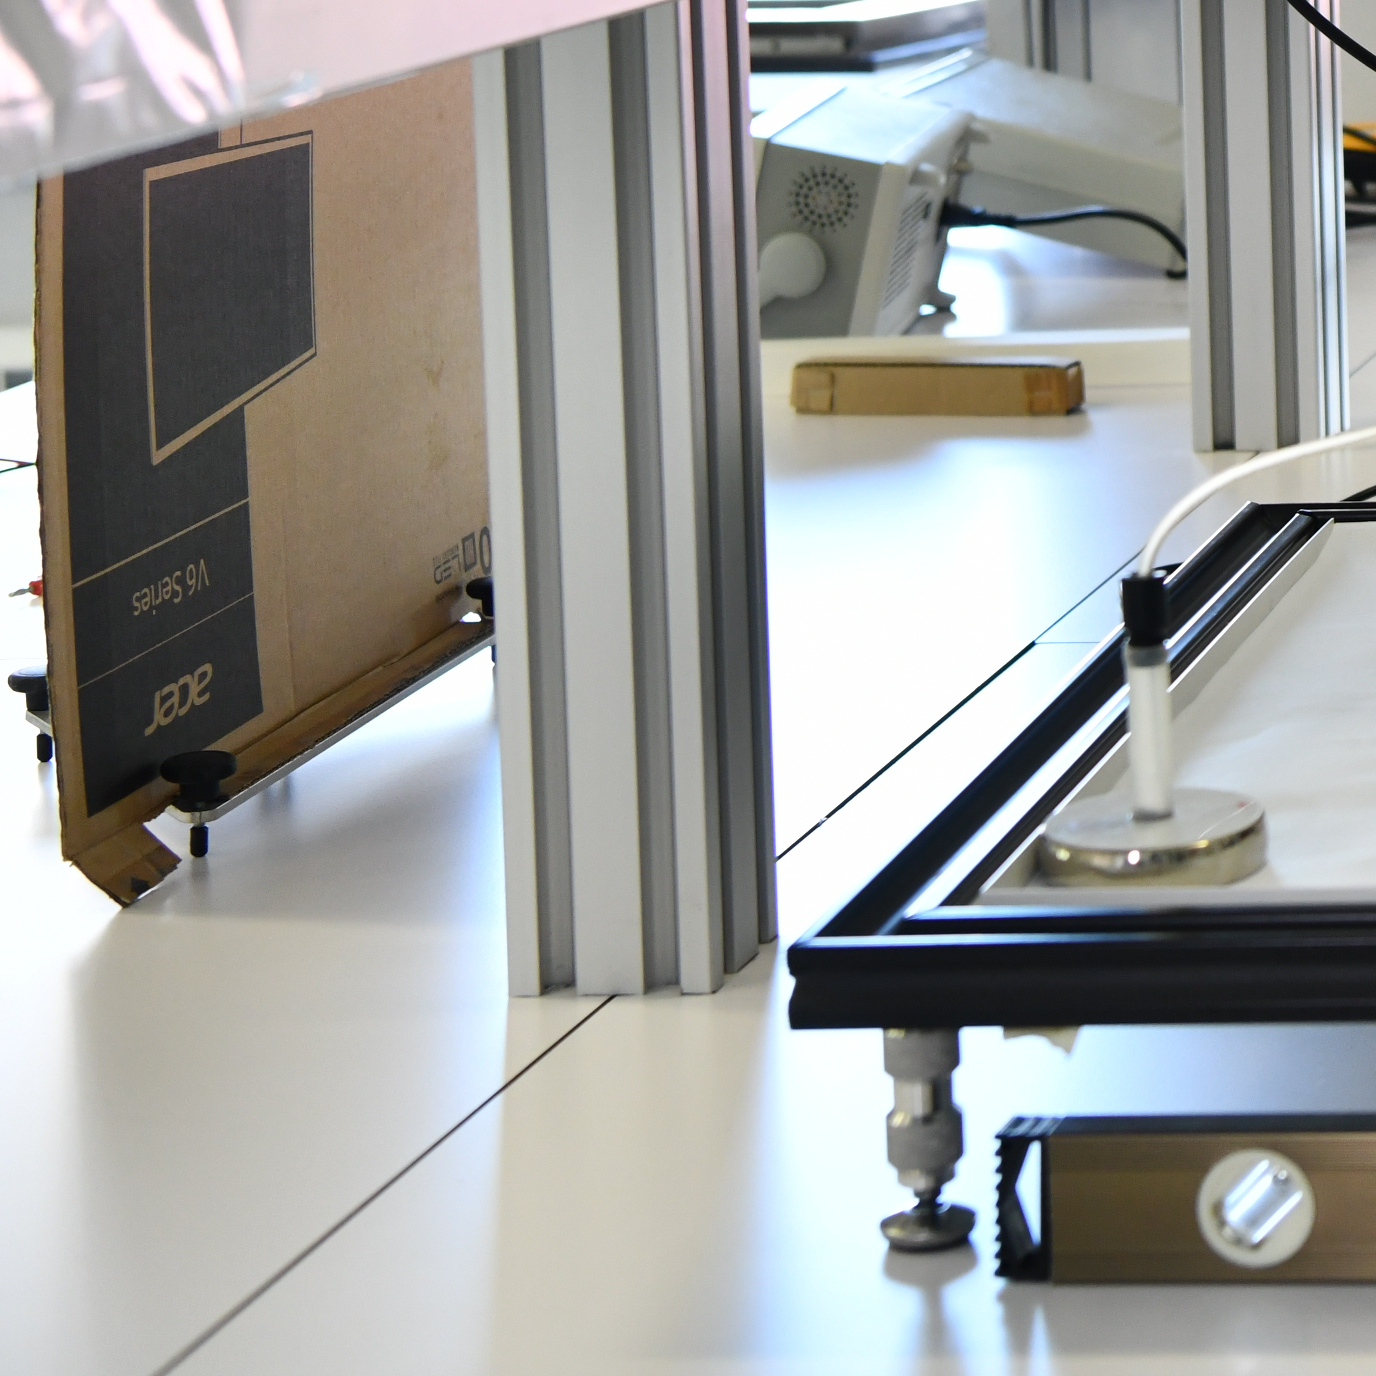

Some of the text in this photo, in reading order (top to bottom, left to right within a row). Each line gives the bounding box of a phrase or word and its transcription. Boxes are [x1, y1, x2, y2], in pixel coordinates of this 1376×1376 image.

[132, 558, 210, 616] V6 Series
[144, 662, 213, 737] acer
